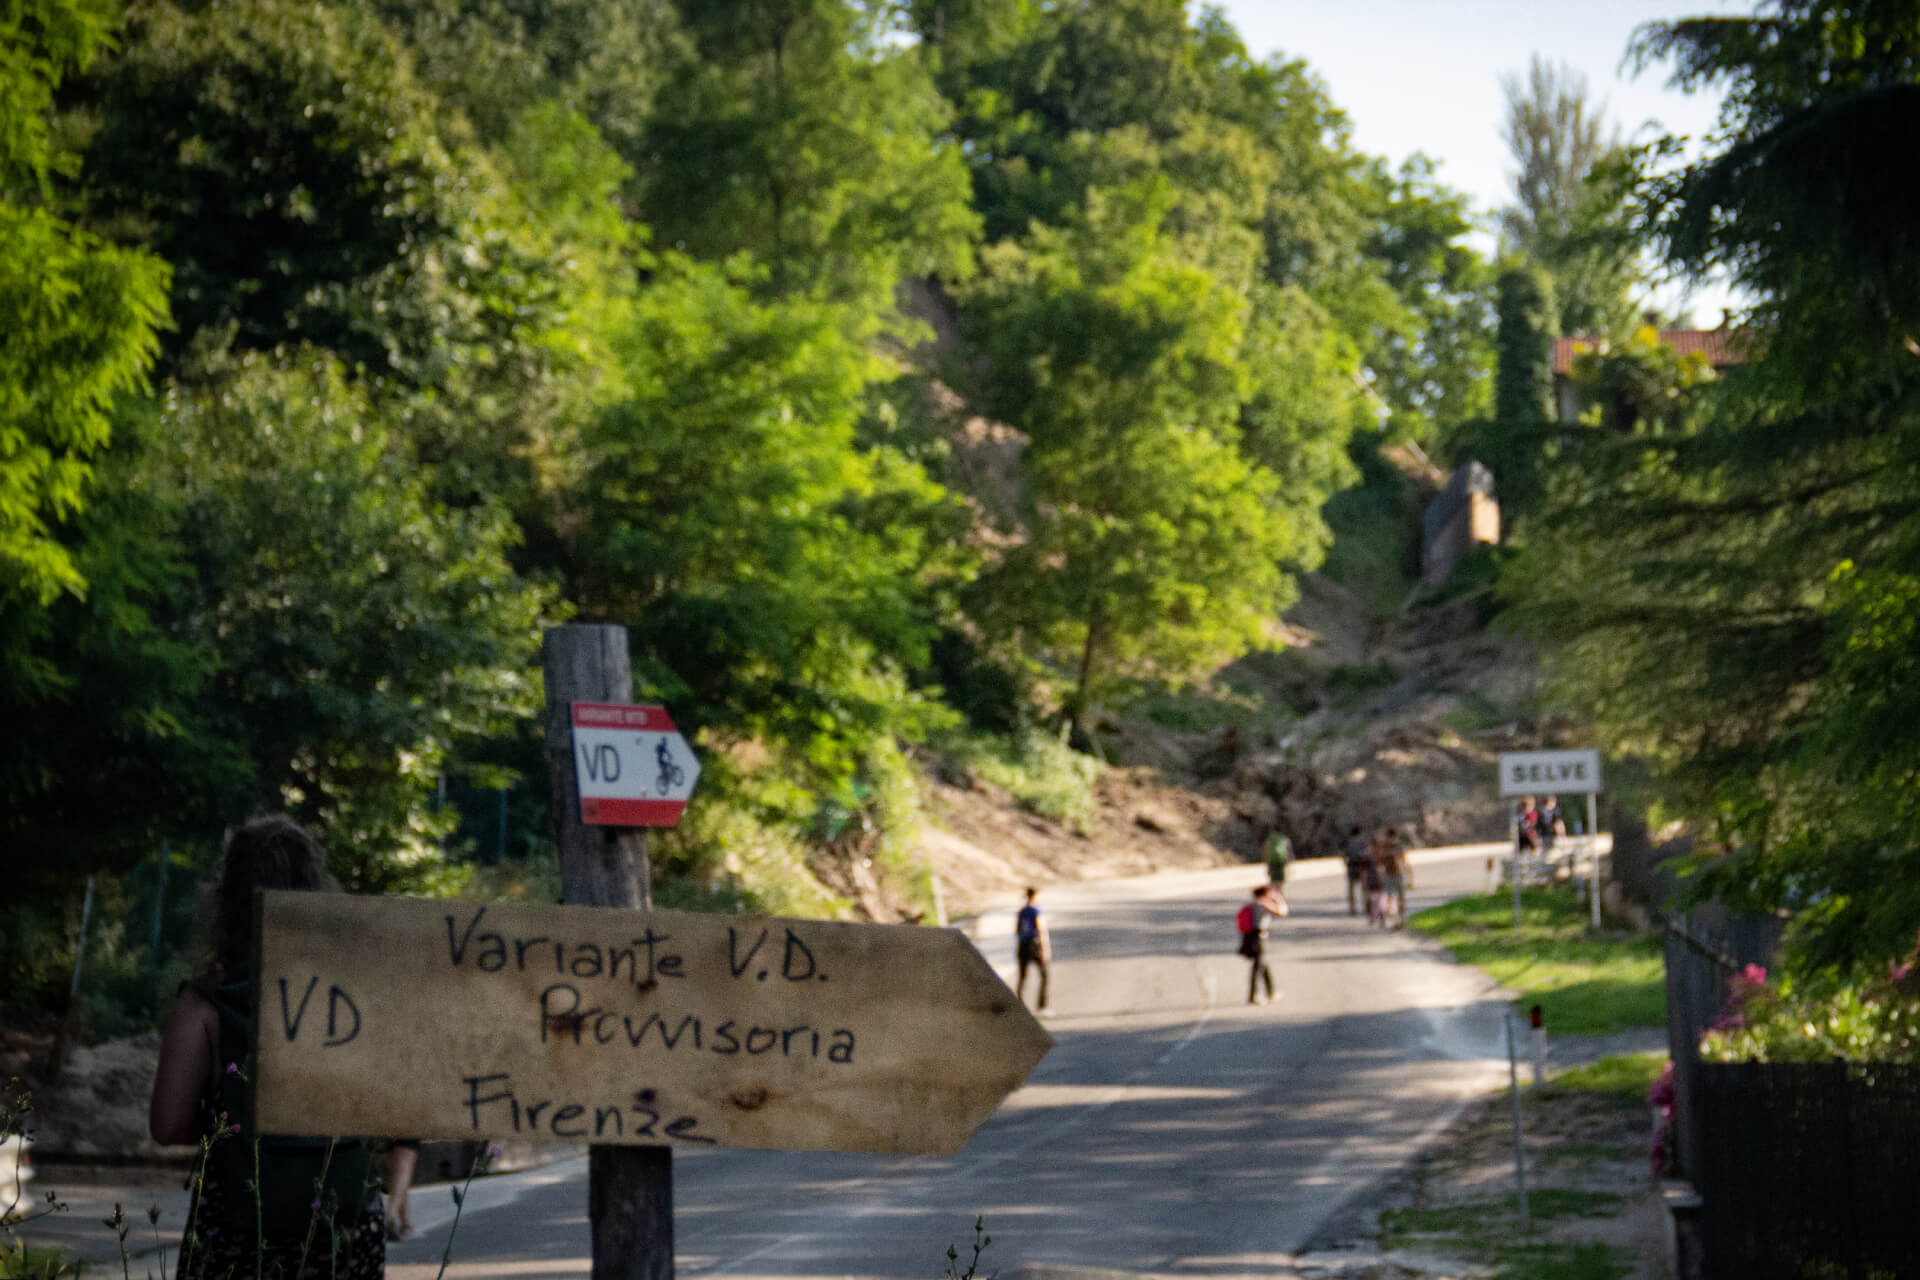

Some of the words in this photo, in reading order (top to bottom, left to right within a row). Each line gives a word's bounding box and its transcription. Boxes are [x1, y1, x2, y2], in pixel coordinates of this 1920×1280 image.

[581, 744, 621, 783] VD
[1512, 761, 1586, 783] SELVE
[444, 906, 686, 985] Variante
[728, 927, 829, 982] V.D.
[279, 975, 362, 1047] VD
[462, 1073, 717, 1144] Firenze
